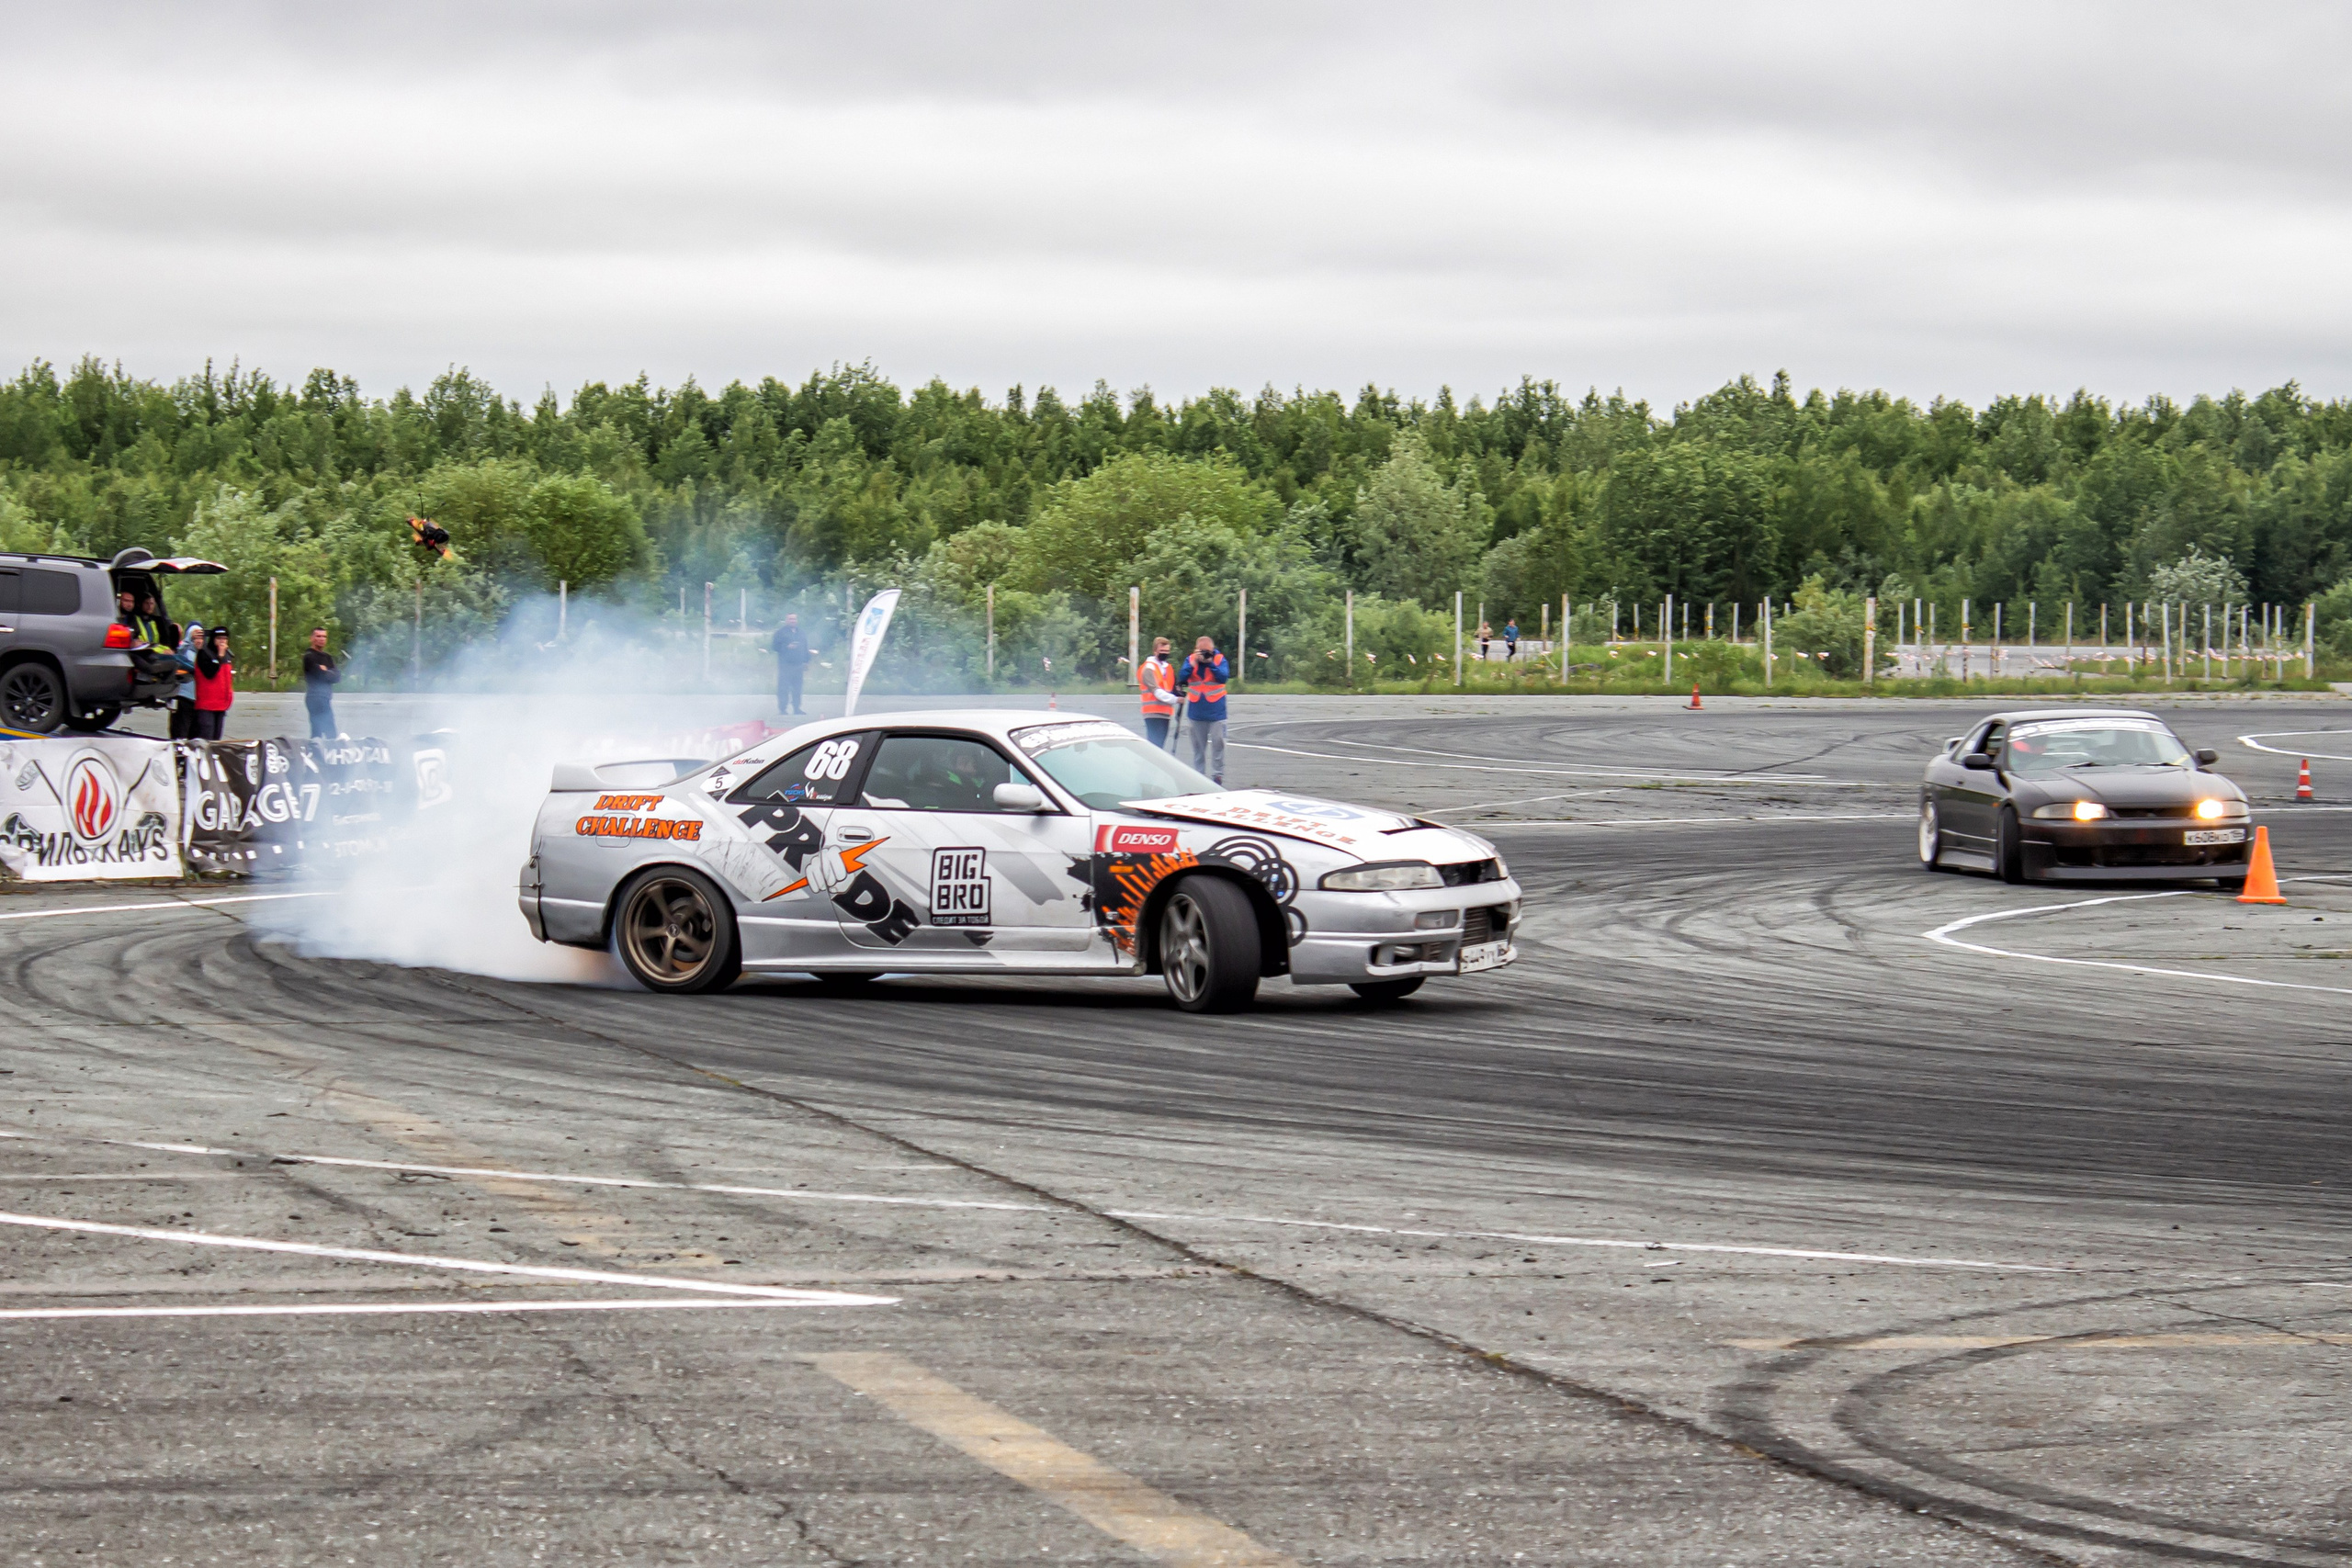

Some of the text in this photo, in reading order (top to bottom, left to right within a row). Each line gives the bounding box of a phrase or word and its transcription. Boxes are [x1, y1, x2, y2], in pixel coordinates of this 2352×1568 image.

[804, 739, 859, 781] 68
[715, 777, 723, 789] 5
[594, 795, 664, 811] DRIFT
[575, 816, 704, 841] CHALLENGE
[1164, 804, 1358, 845] CHALLENGE
[1227, 807, 1328, 829] DRIFT
[1118, 832, 1172, 845] DENSO
[938, 854, 978, 880] BIG
[937, 884, 983, 909] BRO
